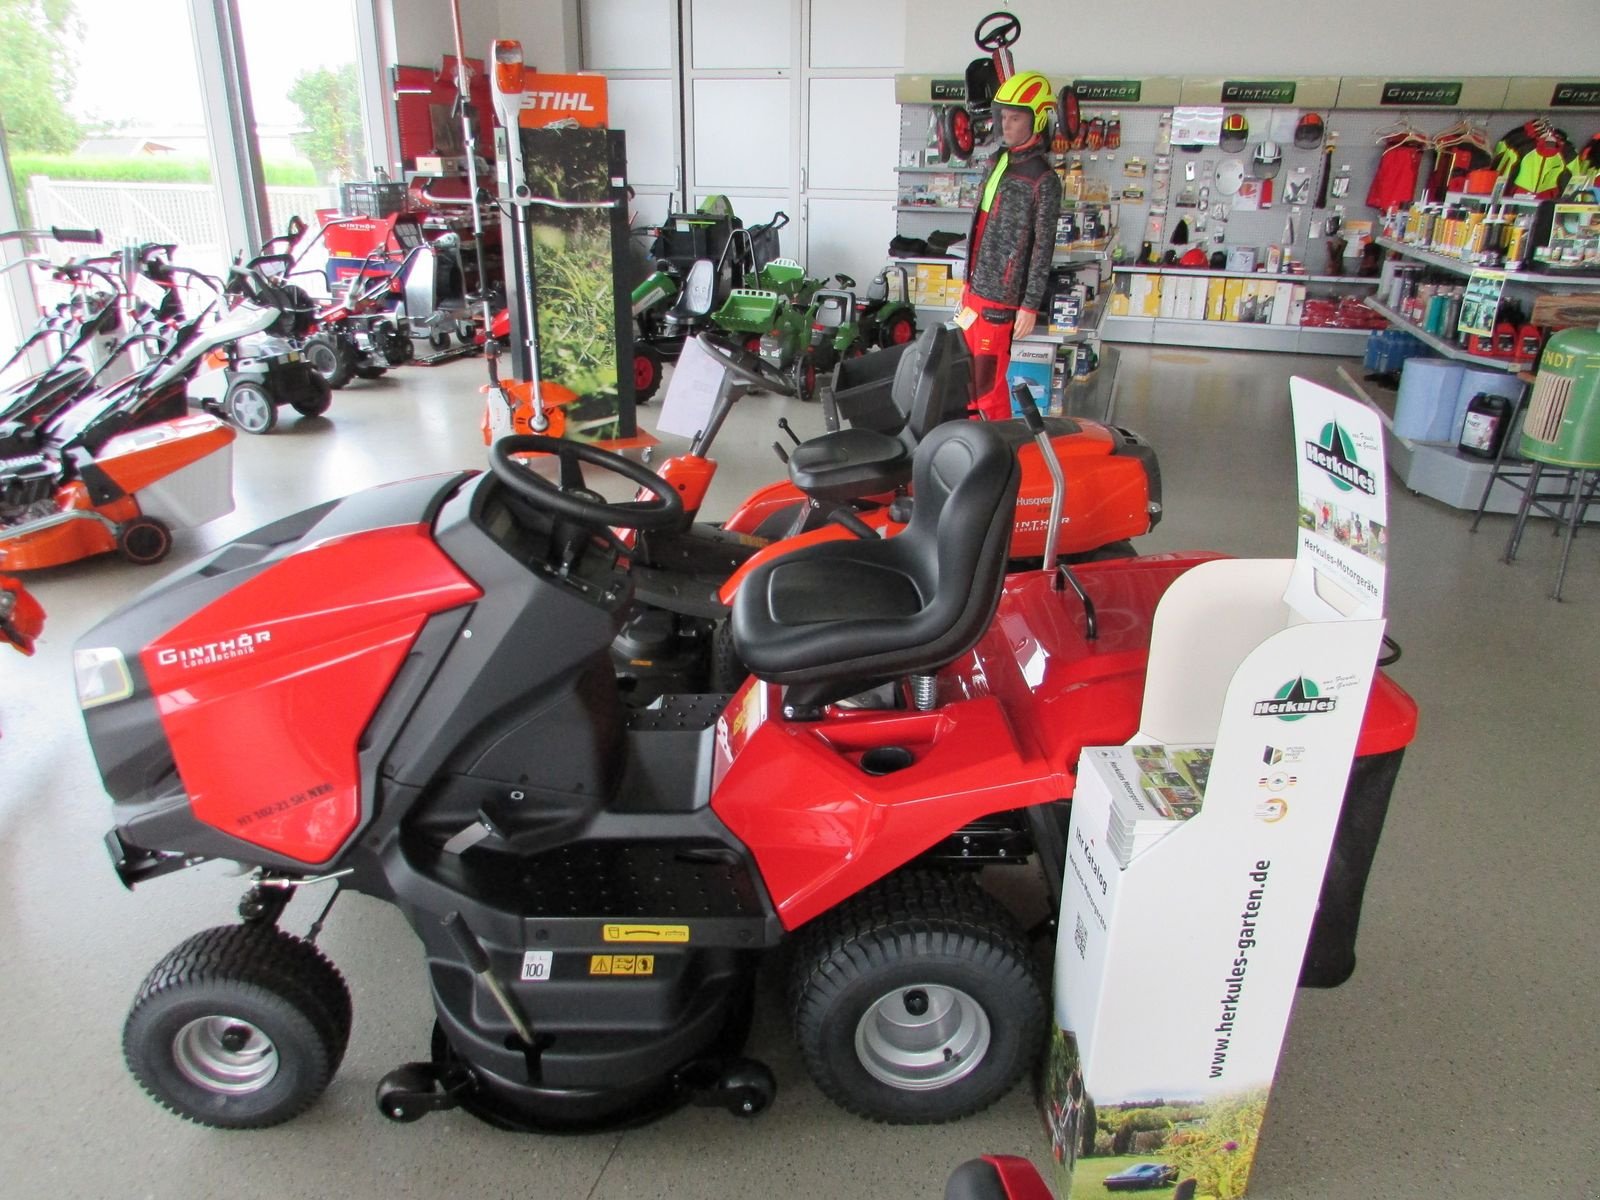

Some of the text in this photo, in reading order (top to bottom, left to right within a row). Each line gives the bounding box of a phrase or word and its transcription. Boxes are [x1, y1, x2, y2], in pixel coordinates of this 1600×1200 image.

[935, 85, 965, 97] GINT
[1559, 89, 1600, 101] GINT
[520, 91, 595, 112] STIHL
[1305, 441, 1376, 496] Herkules
[1016, 496, 1054, 507] Husqvar
[1015, 517, 1070, 531] INTHR
[1304, 537, 1379, 597] Herkules-Motorgeräte
[1253, 699, 1337, 716] Herkules
[1083, 842, 1108, 896] Katalog
[525, 963, 544, 977] 100
[1209, 859, 1271, 1079] www.herkules-garten.de
